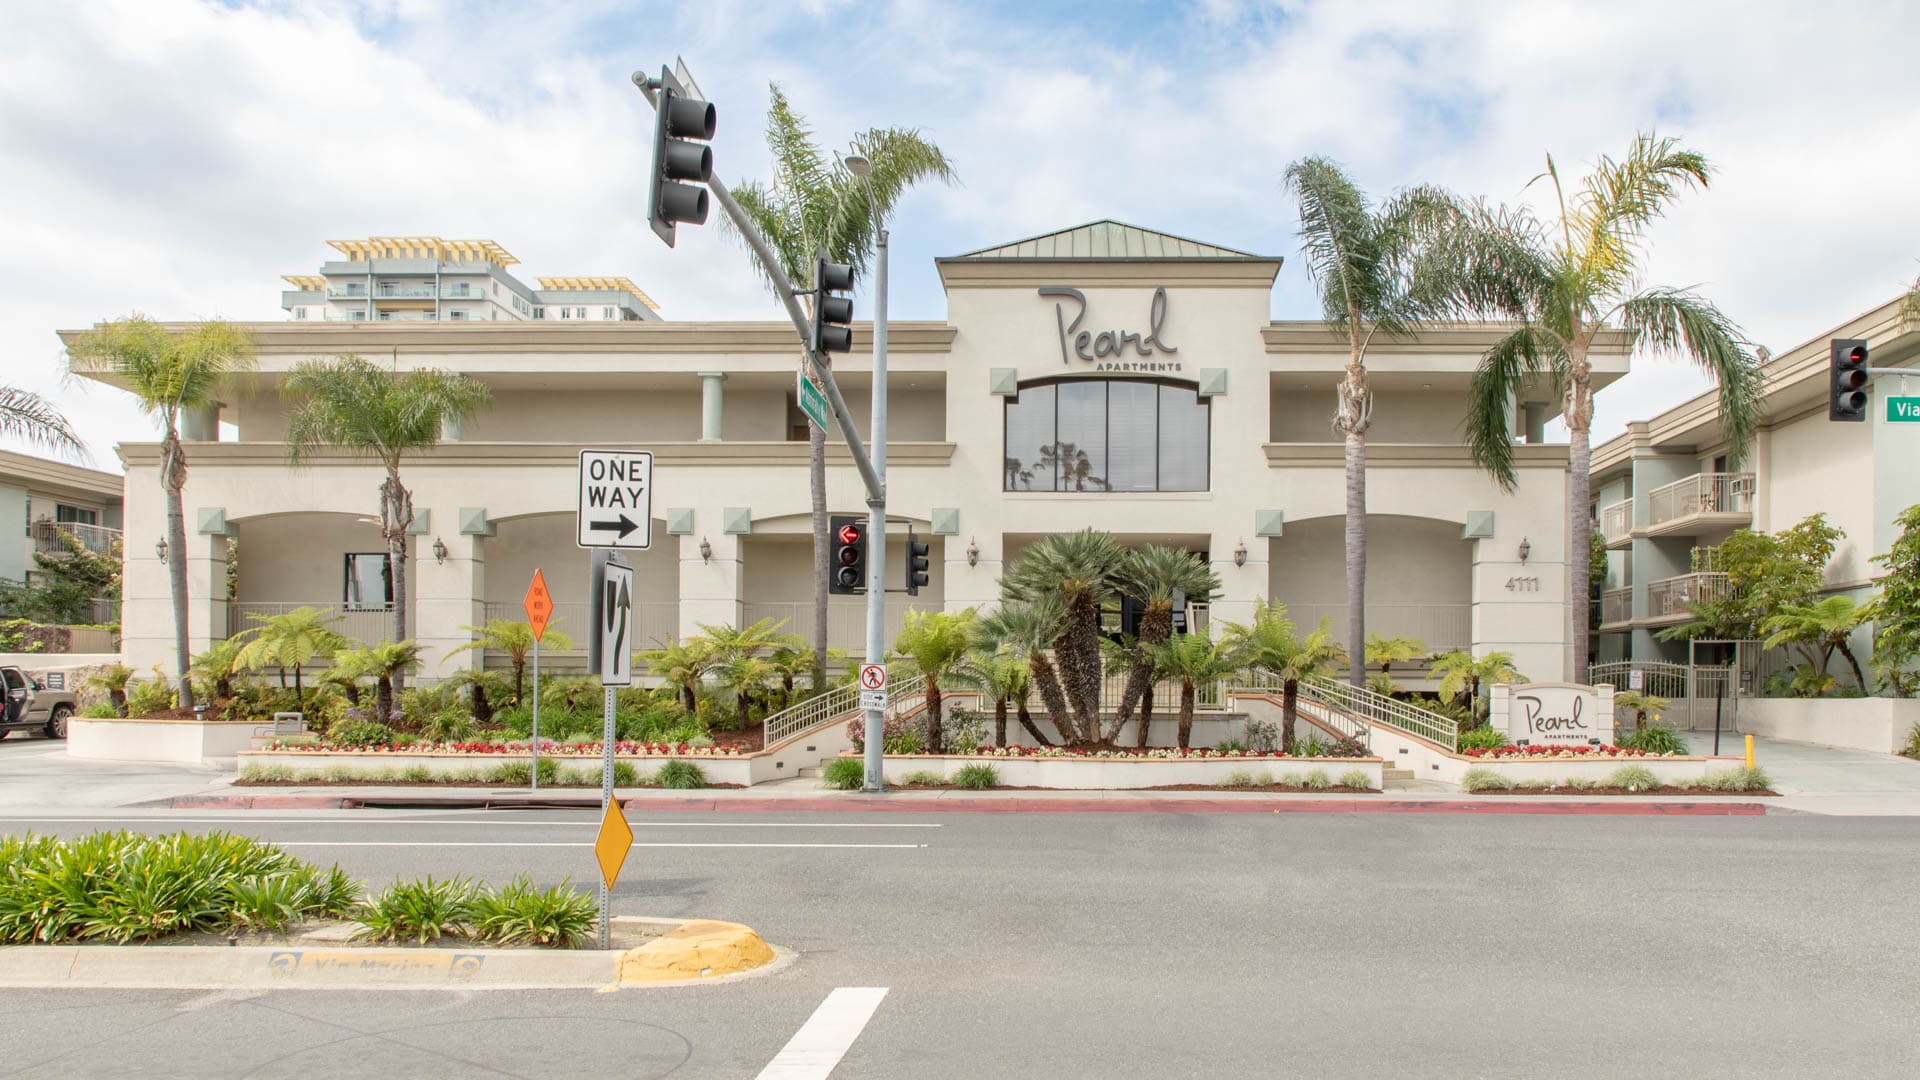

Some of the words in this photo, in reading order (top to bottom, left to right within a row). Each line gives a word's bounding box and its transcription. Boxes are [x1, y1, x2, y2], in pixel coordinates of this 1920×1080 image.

[1037, 287, 1178, 365] Pearl
[1096, 363, 1182, 372] APARTMENTS
[1896, 402, 1920, 417] Via
[590, 459, 643, 482] ONE
[588, 486, 644, 508] WAY
[1504, 576, 1540, 592] 4111
[1517, 695, 1588, 734] Pearl
